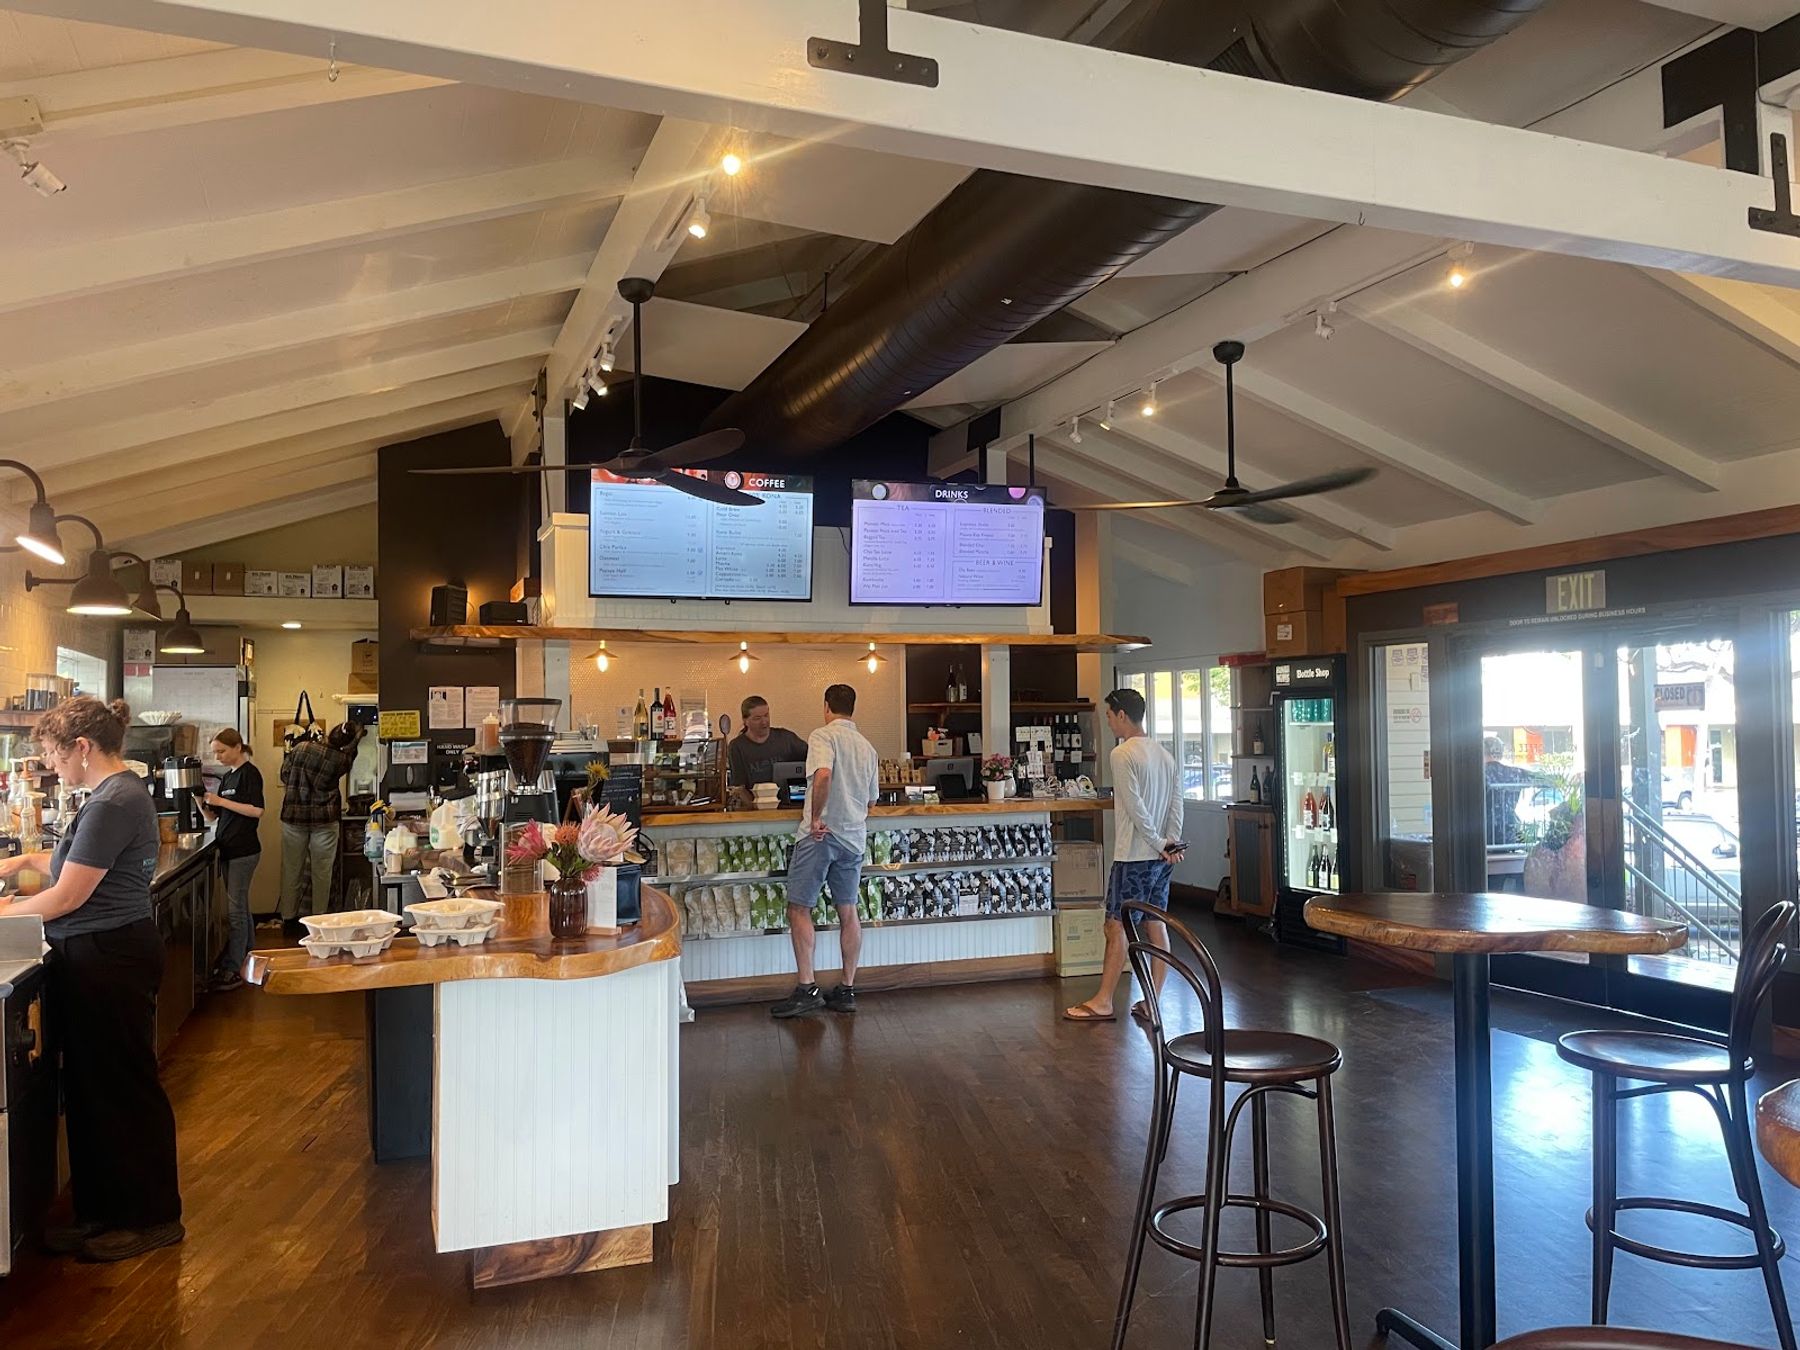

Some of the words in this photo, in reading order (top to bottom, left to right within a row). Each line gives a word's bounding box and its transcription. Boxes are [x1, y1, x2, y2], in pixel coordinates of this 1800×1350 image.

[748, 478, 786, 489] COFFEE
[935, 489, 969, 499] DRINKS
[1557, 573, 1595, 612] EXIT
[1531, 616, 1549, 625] REMAIN
[1550, 614, 1577, 623] UNLOCKED
[1578, 612, 1598, 621] DURING
[1598, 610, 1625, 619] BUSINESS
[1626, 607, 1646, 617] HOURS
[1296, 669, 1315, 679] Bottle
[1315, 668, 1330, 679] Shop
